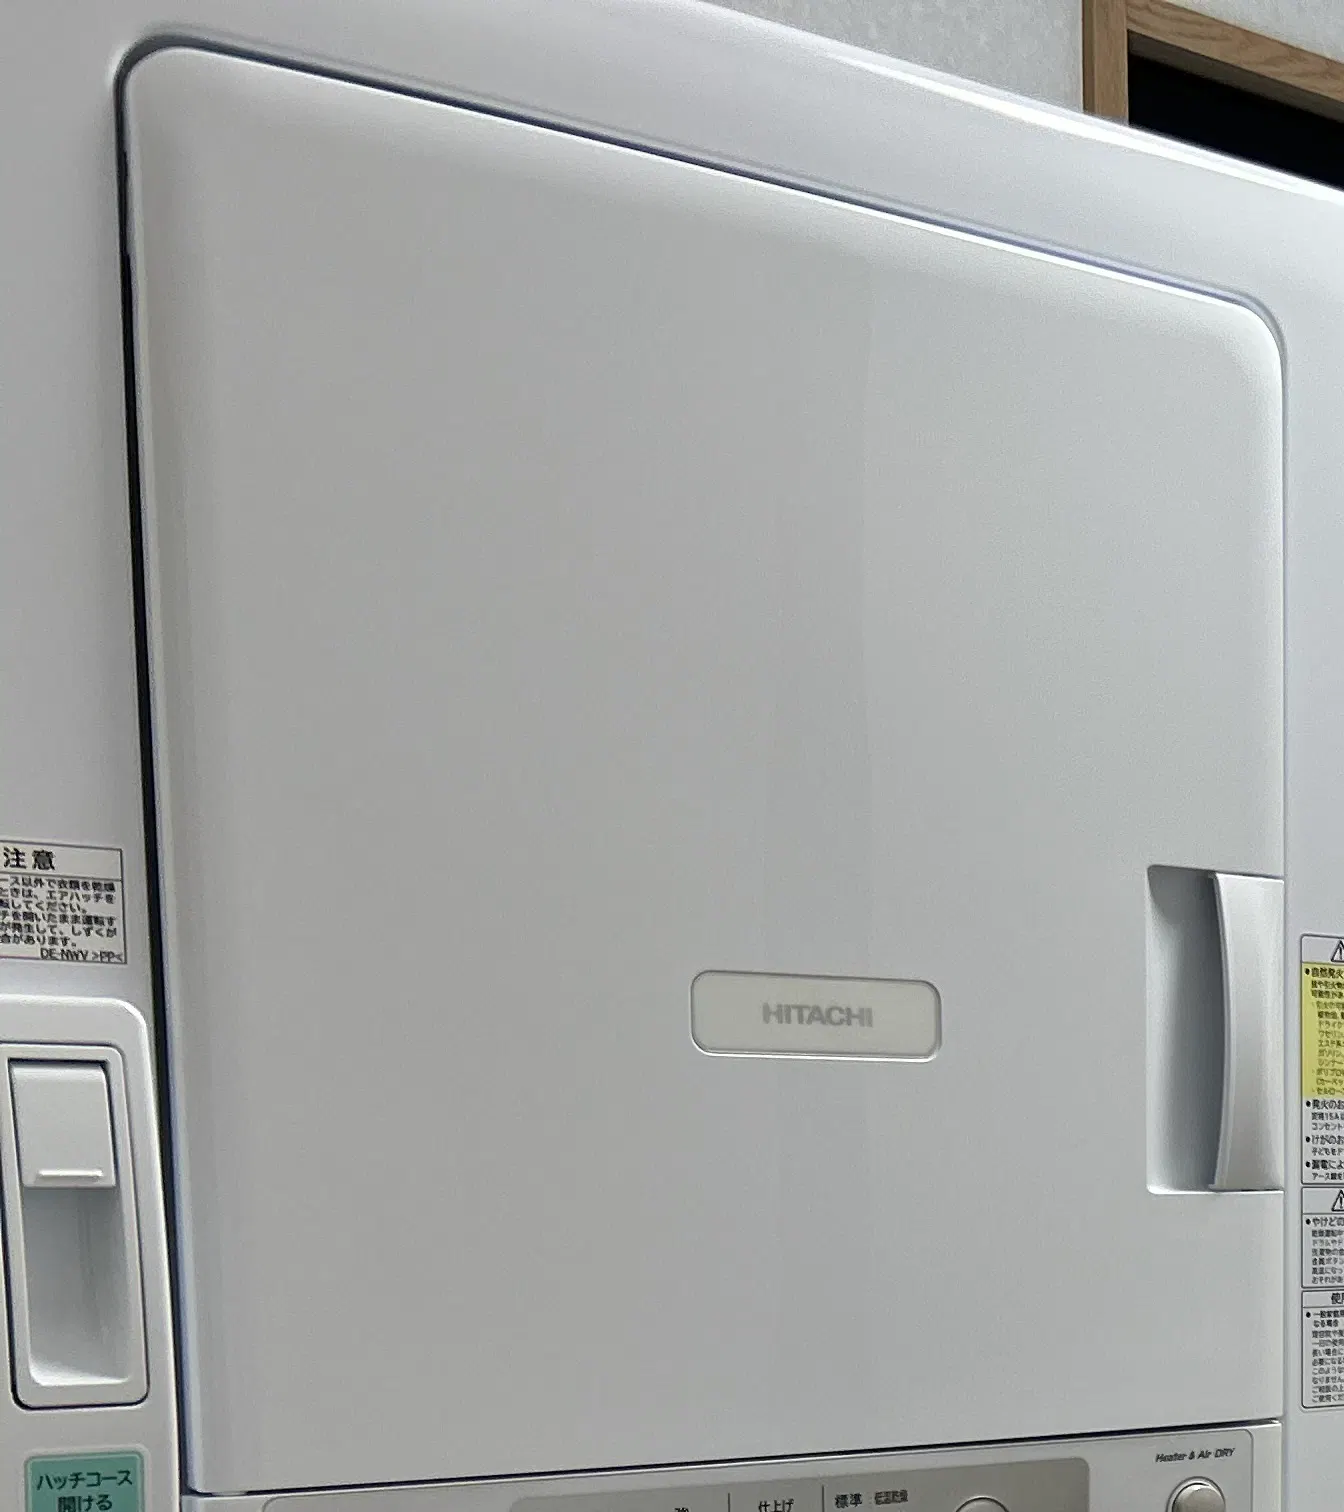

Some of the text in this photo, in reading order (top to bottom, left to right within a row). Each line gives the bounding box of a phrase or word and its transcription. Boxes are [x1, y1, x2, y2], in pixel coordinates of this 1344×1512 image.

[3, 847, 55, 870] 注意
[762, 1002, 873, 1028] HITACHI
[36, 1469, 133, 1491] ハッチコース
[834, 1492, 862, 1508] 標準
